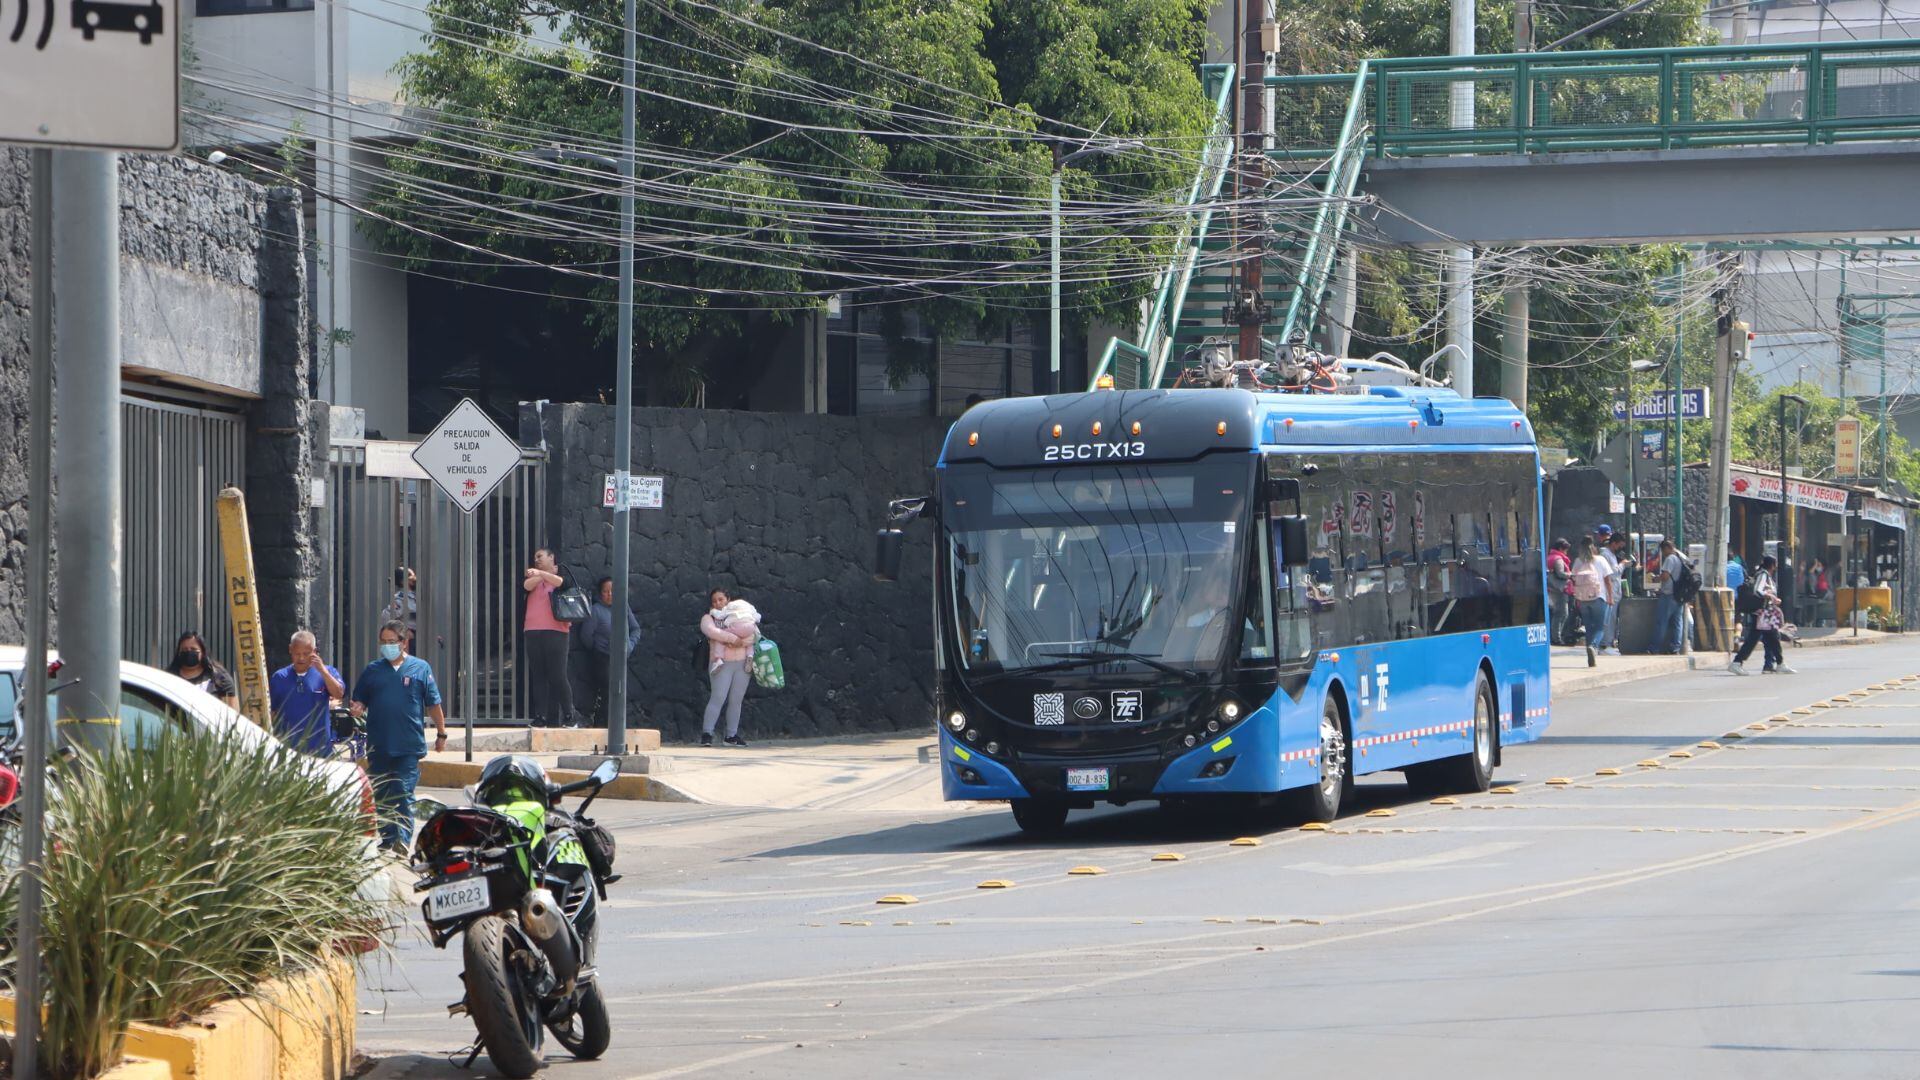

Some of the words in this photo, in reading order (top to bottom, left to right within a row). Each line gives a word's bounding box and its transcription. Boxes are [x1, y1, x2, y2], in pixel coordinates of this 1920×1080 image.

[443, 429, 490, 438] PRECAUCION
[453, 441, 480, 451] SALIDA
[1044, 442, 1145, 461] 25CTX13
[461, 453, 472, 463] DE
[446, 465, 488, 474] VEHICULOS
[1760, 478, 1779, 490] SITIO
[1797, 483, 1814, 498] TAXI
[1815, 487, 1845, 503] SEGURO
[232, 576, 248, 606] NO
[436, 888, 481, 909] MXCR23
